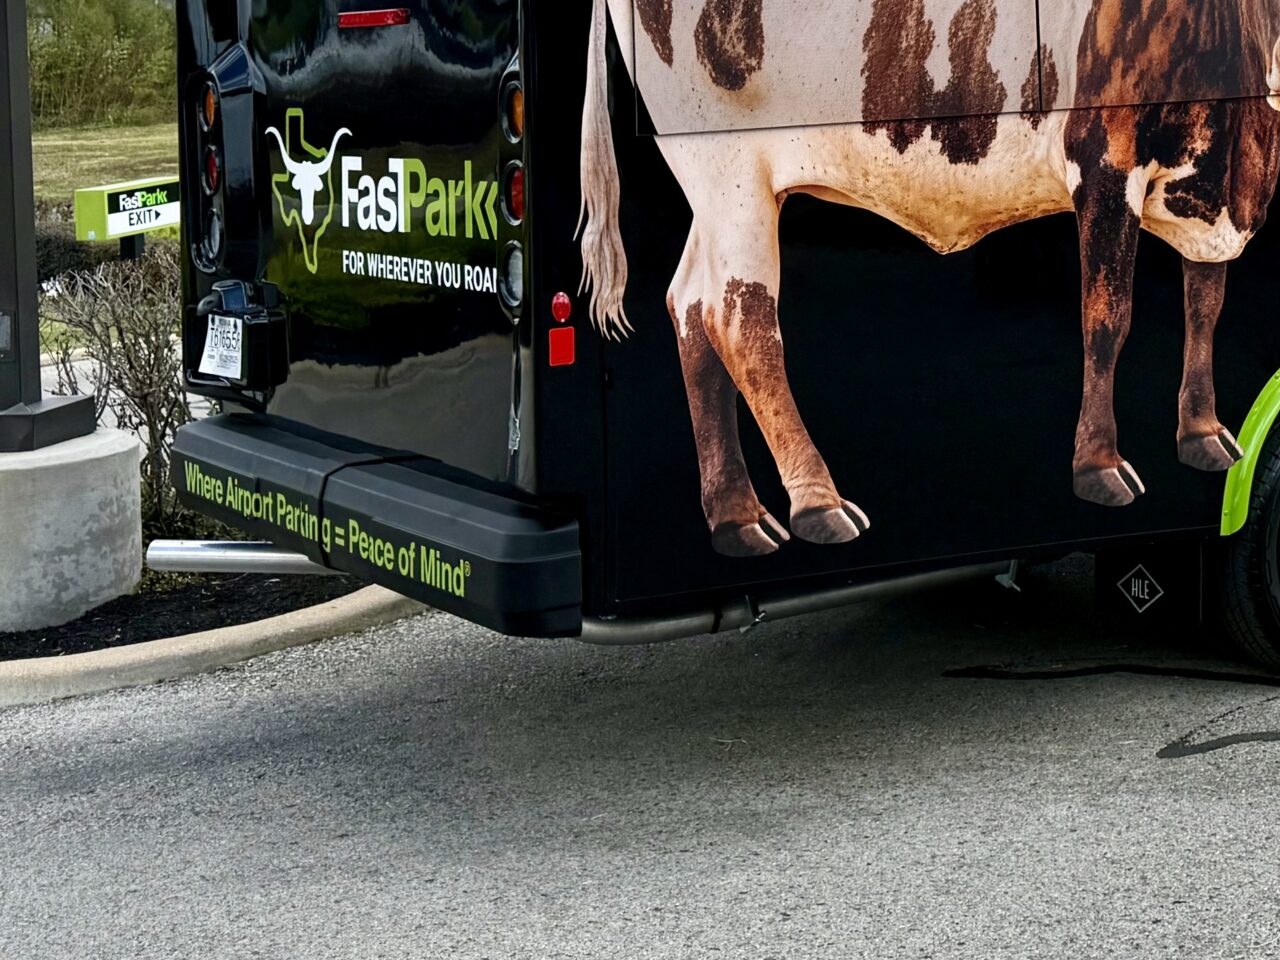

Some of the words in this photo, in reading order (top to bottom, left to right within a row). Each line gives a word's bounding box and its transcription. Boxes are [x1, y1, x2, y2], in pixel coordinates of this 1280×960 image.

[128, 209, 153, 227] EXIT
[342, 250, 365, 276] FOR
[367, 253, 433, 285] WHEREVER
[435, 261, 461, 289] YOU
[184, 459, 224, 500] Where
[225, 476, 274, 524] Airport
[276, 492, 332, 553] Parking
[334, 525, 346, 547] =
[348, 519, 395, 570] Peace
[397, 542, 417, 577] of
